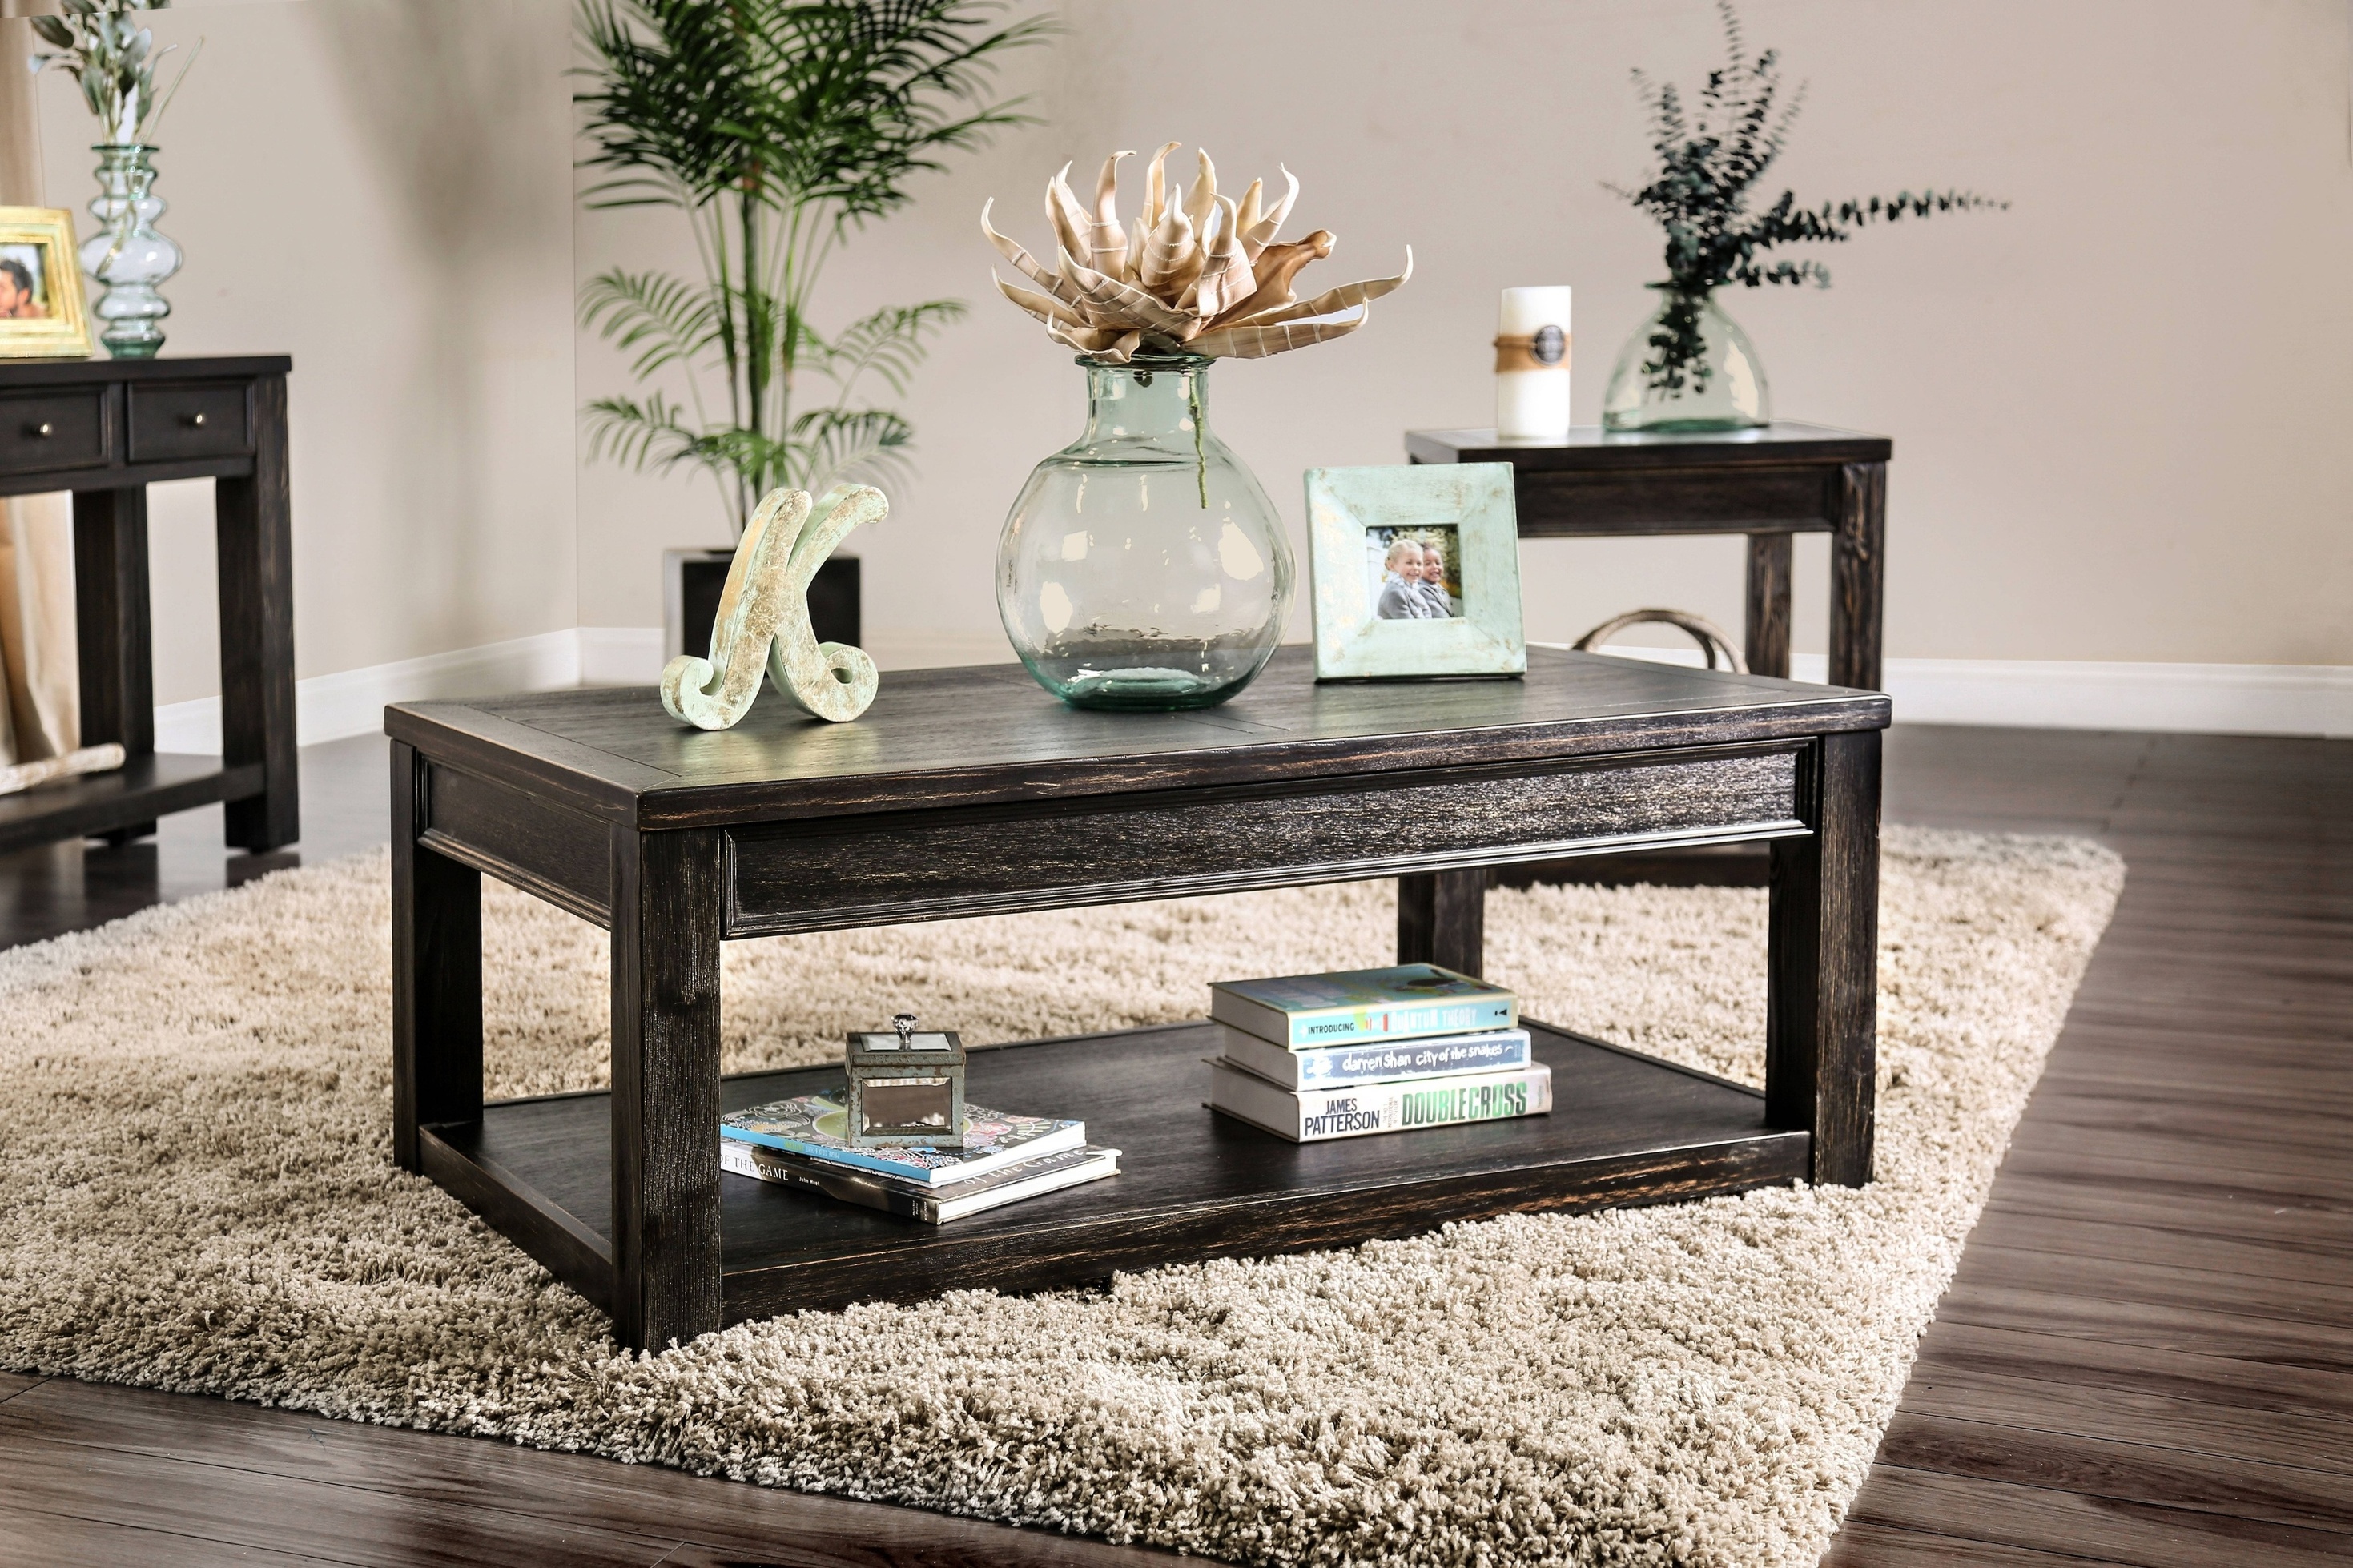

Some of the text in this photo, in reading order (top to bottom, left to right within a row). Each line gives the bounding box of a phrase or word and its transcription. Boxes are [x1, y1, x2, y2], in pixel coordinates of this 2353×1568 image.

[1308, 1007, 1478, 1035] INTRODUCING QUANTUM THEORY
[1342, 1043, 1503, 1071] darren shan city of the snakes
[1326, 1098, 1358, 1116] JAMES
[1305, 1110, 1380, 1136] PATTERSON
[734, 1156, 755, 1172] THE
[758, 1163, 789, 1181] GAME
[798, 1176, 809, 1184] John
[964, 1149, 1084, 1185] of the Game
